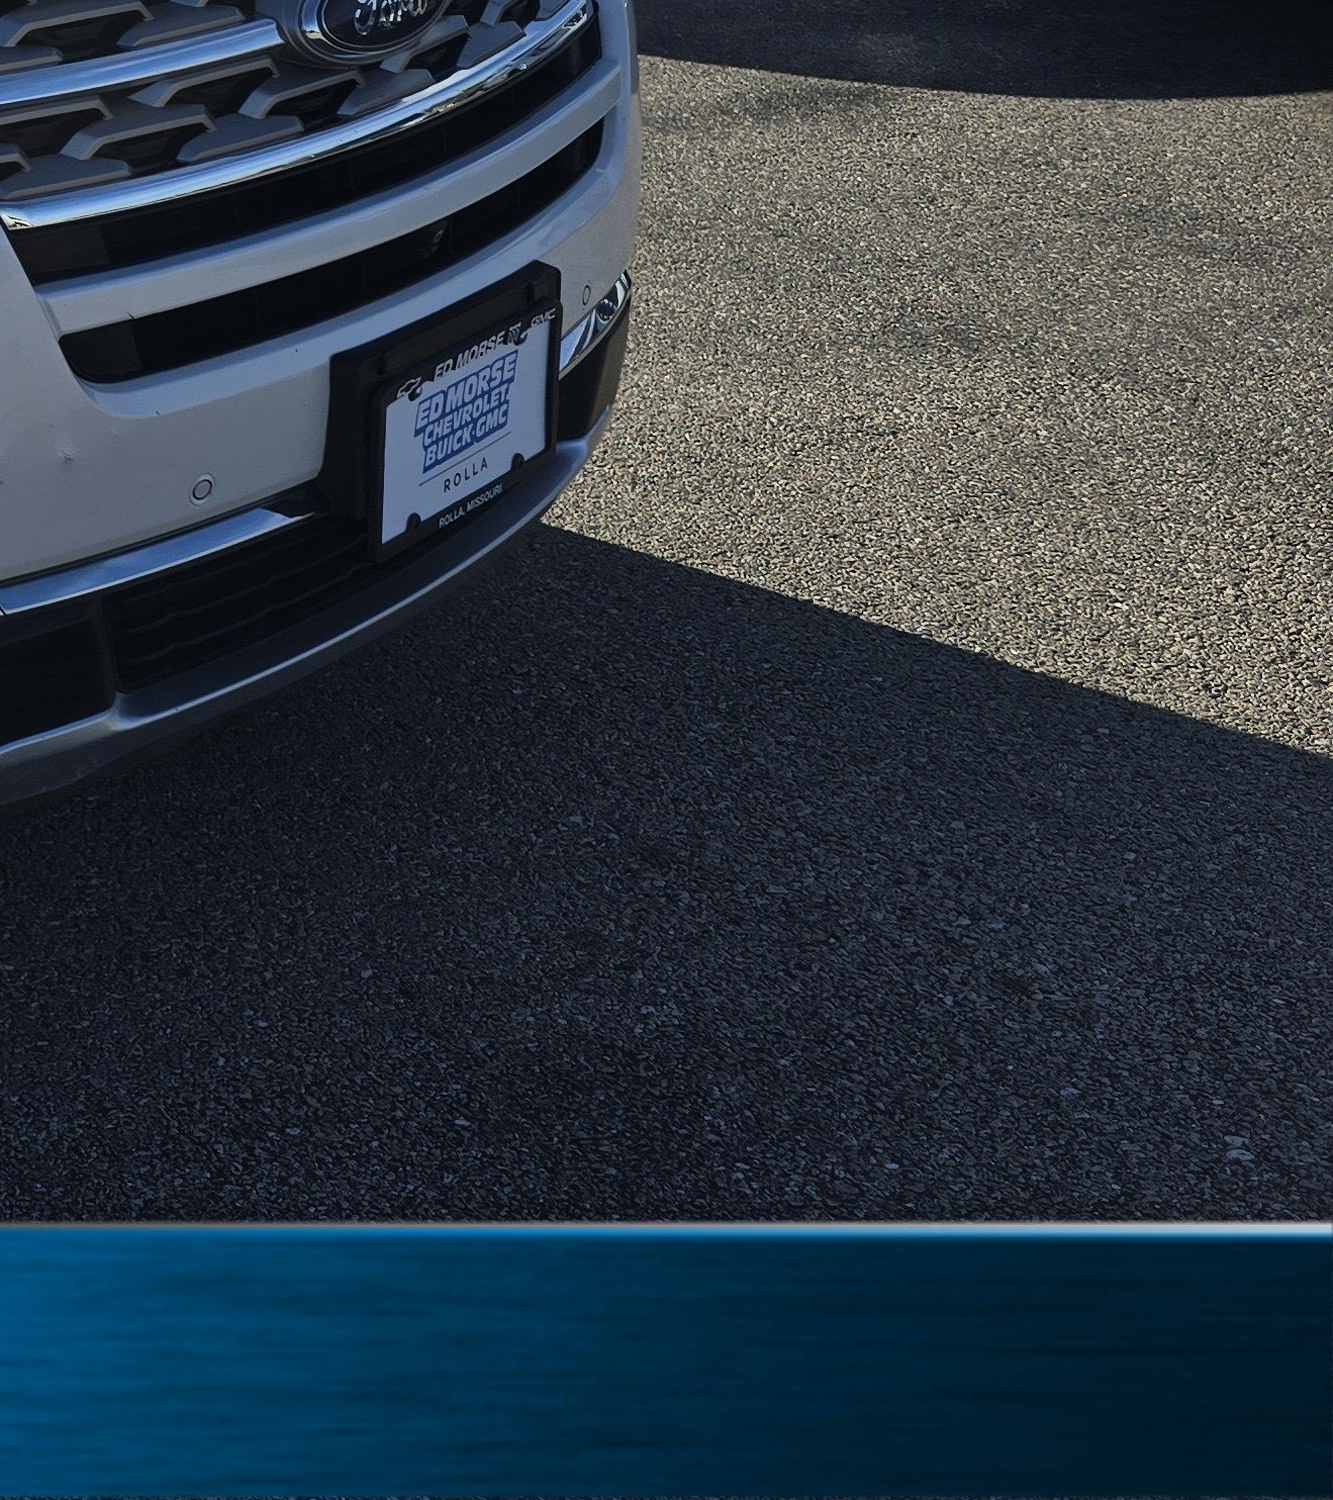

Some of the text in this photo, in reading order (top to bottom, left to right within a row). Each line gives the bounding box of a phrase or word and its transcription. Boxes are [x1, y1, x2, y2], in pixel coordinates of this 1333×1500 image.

[434, 330, 506, 381] ED MORSE
[415, 352, 518, 431] ED MORSE
[423, 383, 511, 445] CHEVROLET
[443, 456, 488, 493] ROLLA
